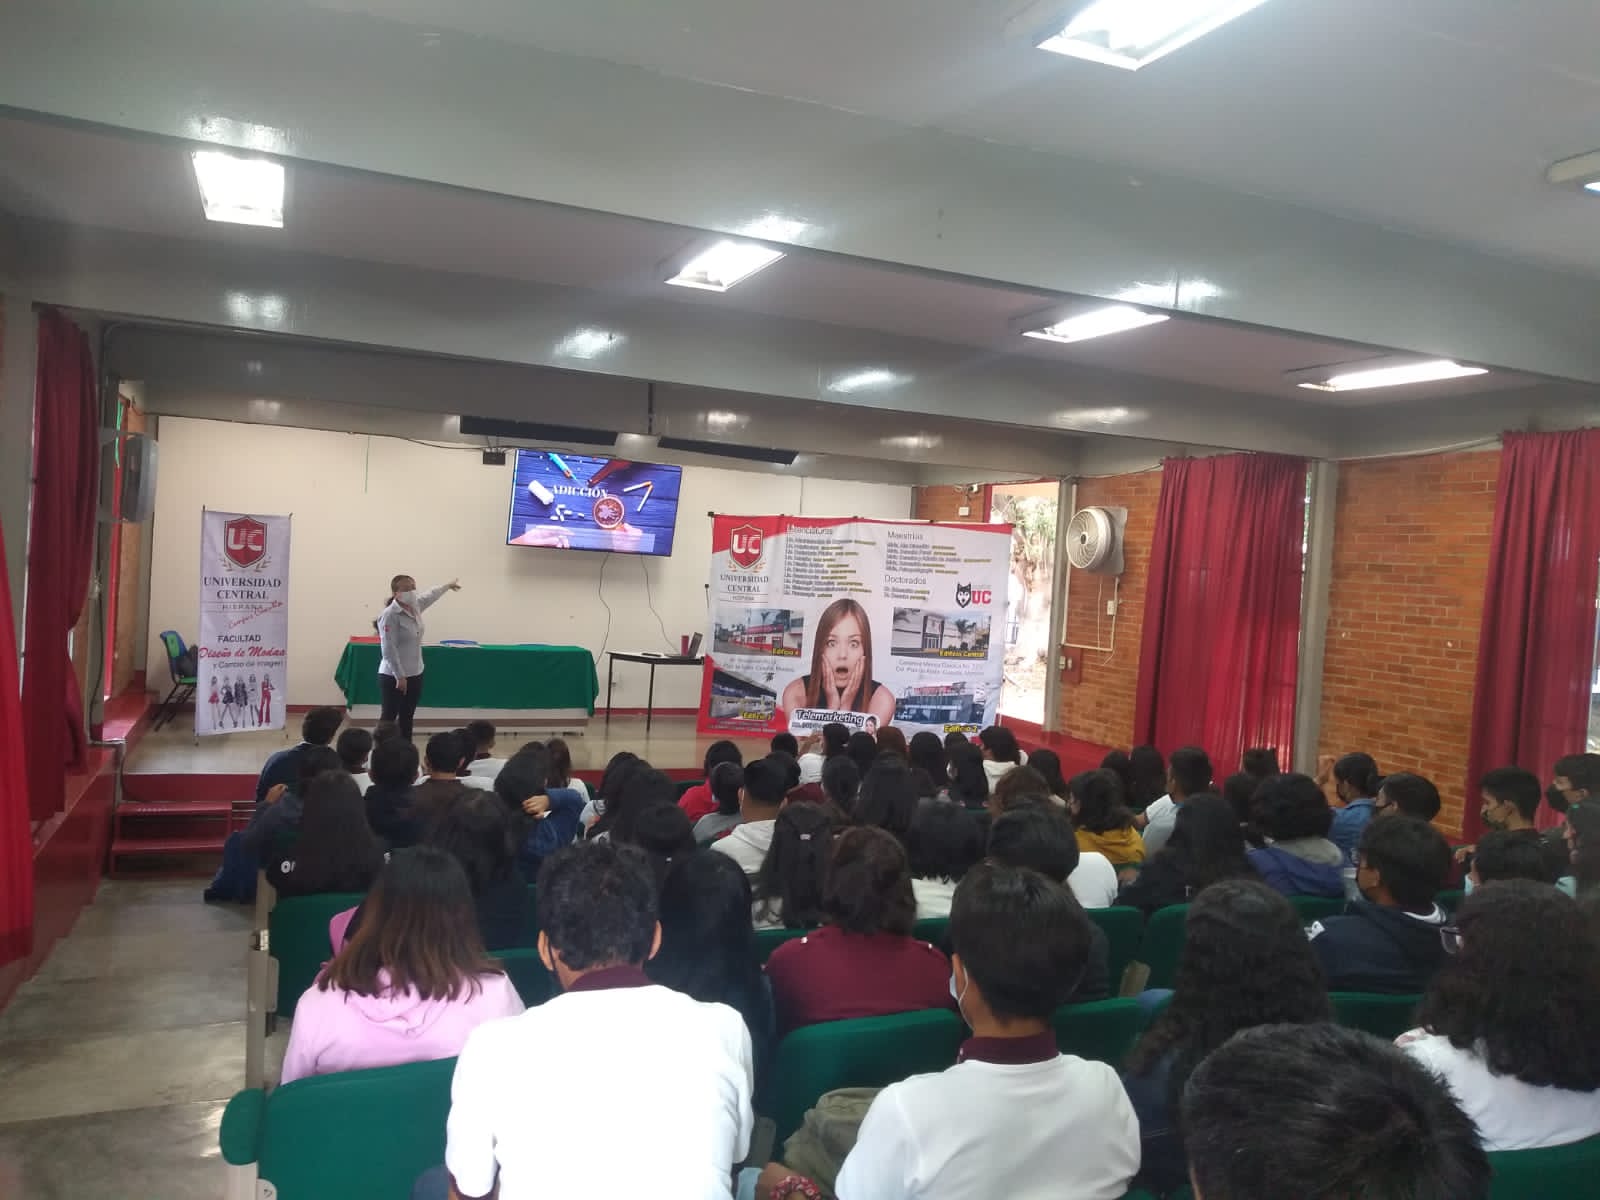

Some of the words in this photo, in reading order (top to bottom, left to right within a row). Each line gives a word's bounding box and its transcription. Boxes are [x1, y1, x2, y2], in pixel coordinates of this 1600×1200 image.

[228, 527, 262, 552] UC
[732, 534, 761, 555] UC
[203, 576, 282, 588] UNIVERSIDAD
[719, 574, 769, 583] UNIVERSIDAD
[884, 574, 927, 585] Doctorados
[727, 584, 761, 593] CENTRAL
[216, 589, 269, 600] CENTRAL
[971, 590, 992, 604] UC
[217, 634, 262, 643] FACULTAD
[234, 648, 245, 657] de
[795, 709, 865, 728] Telemarketing
[944, 724, 971, 733] Edificio
